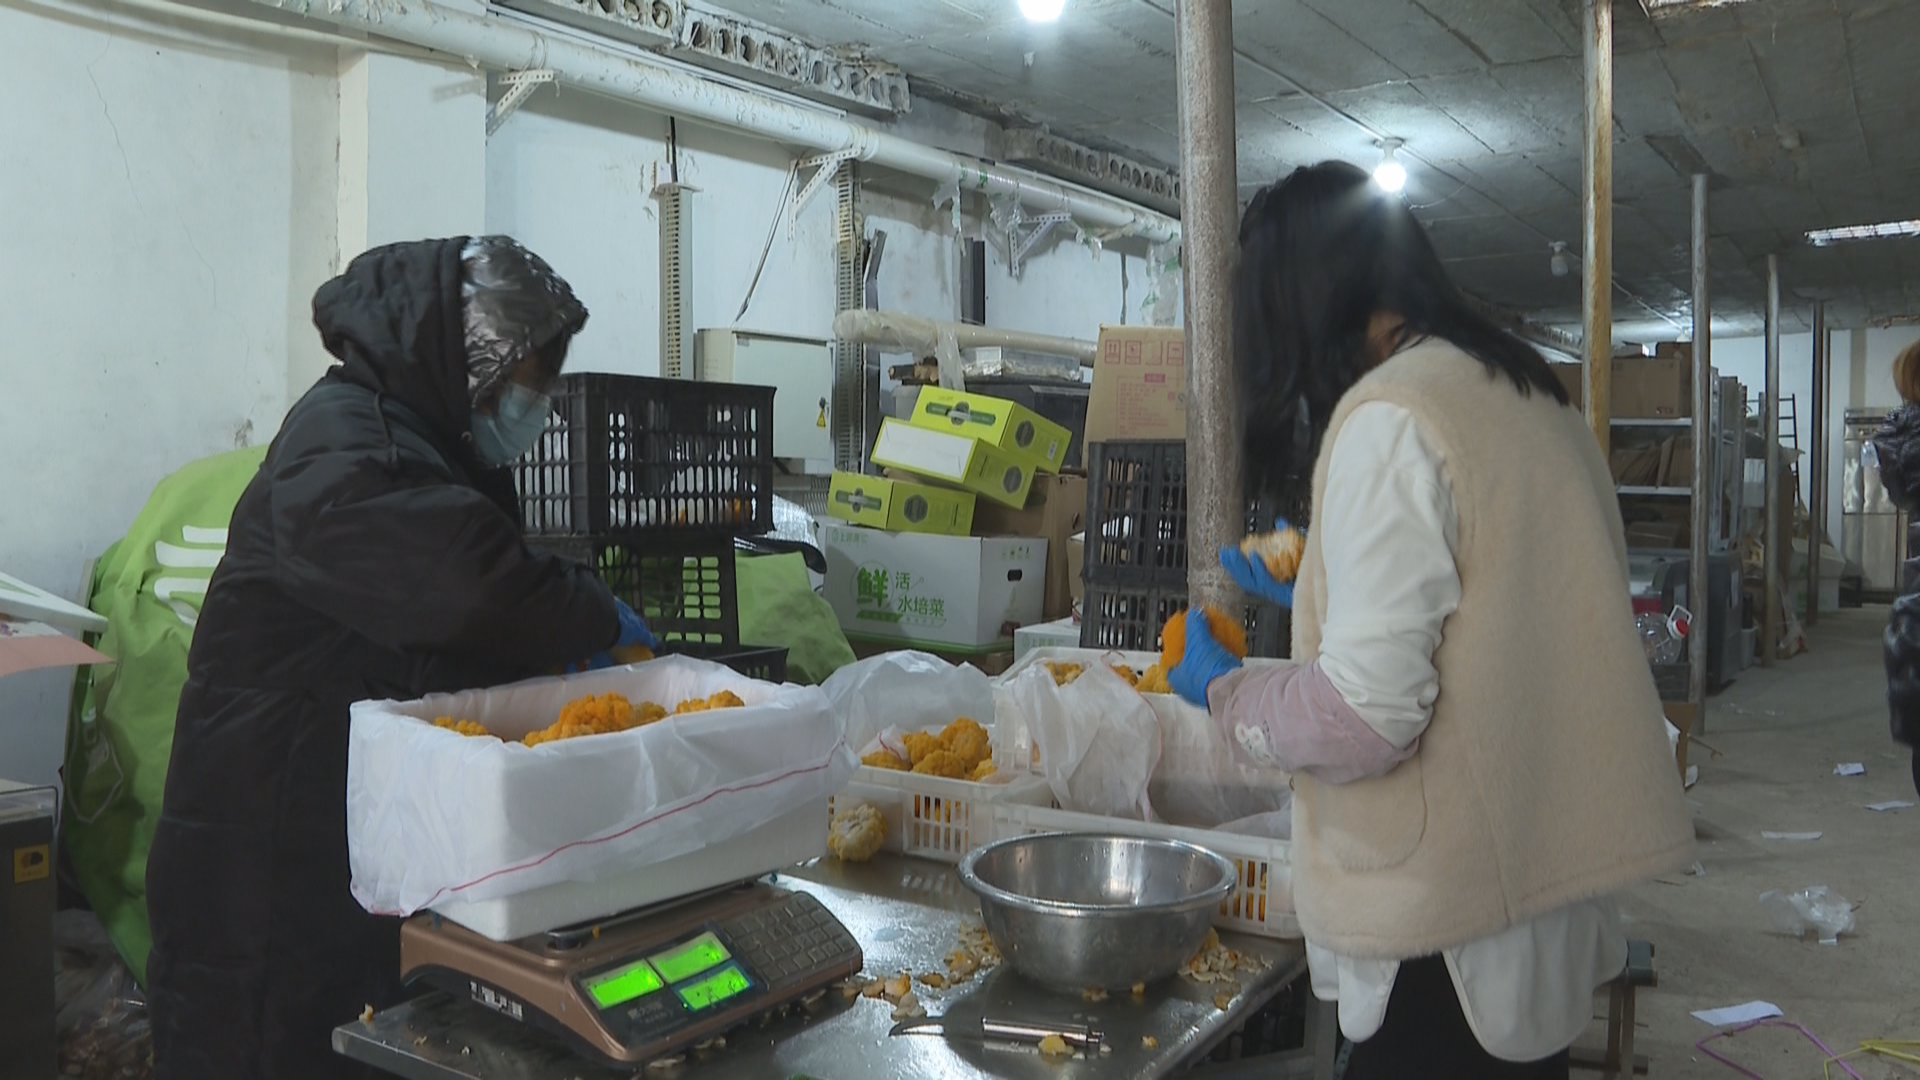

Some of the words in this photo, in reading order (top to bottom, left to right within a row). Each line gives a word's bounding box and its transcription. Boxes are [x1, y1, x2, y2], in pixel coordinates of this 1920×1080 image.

[857, 567, 888, 608] 鲜
[898, 595, 945, 617] 水培菜
